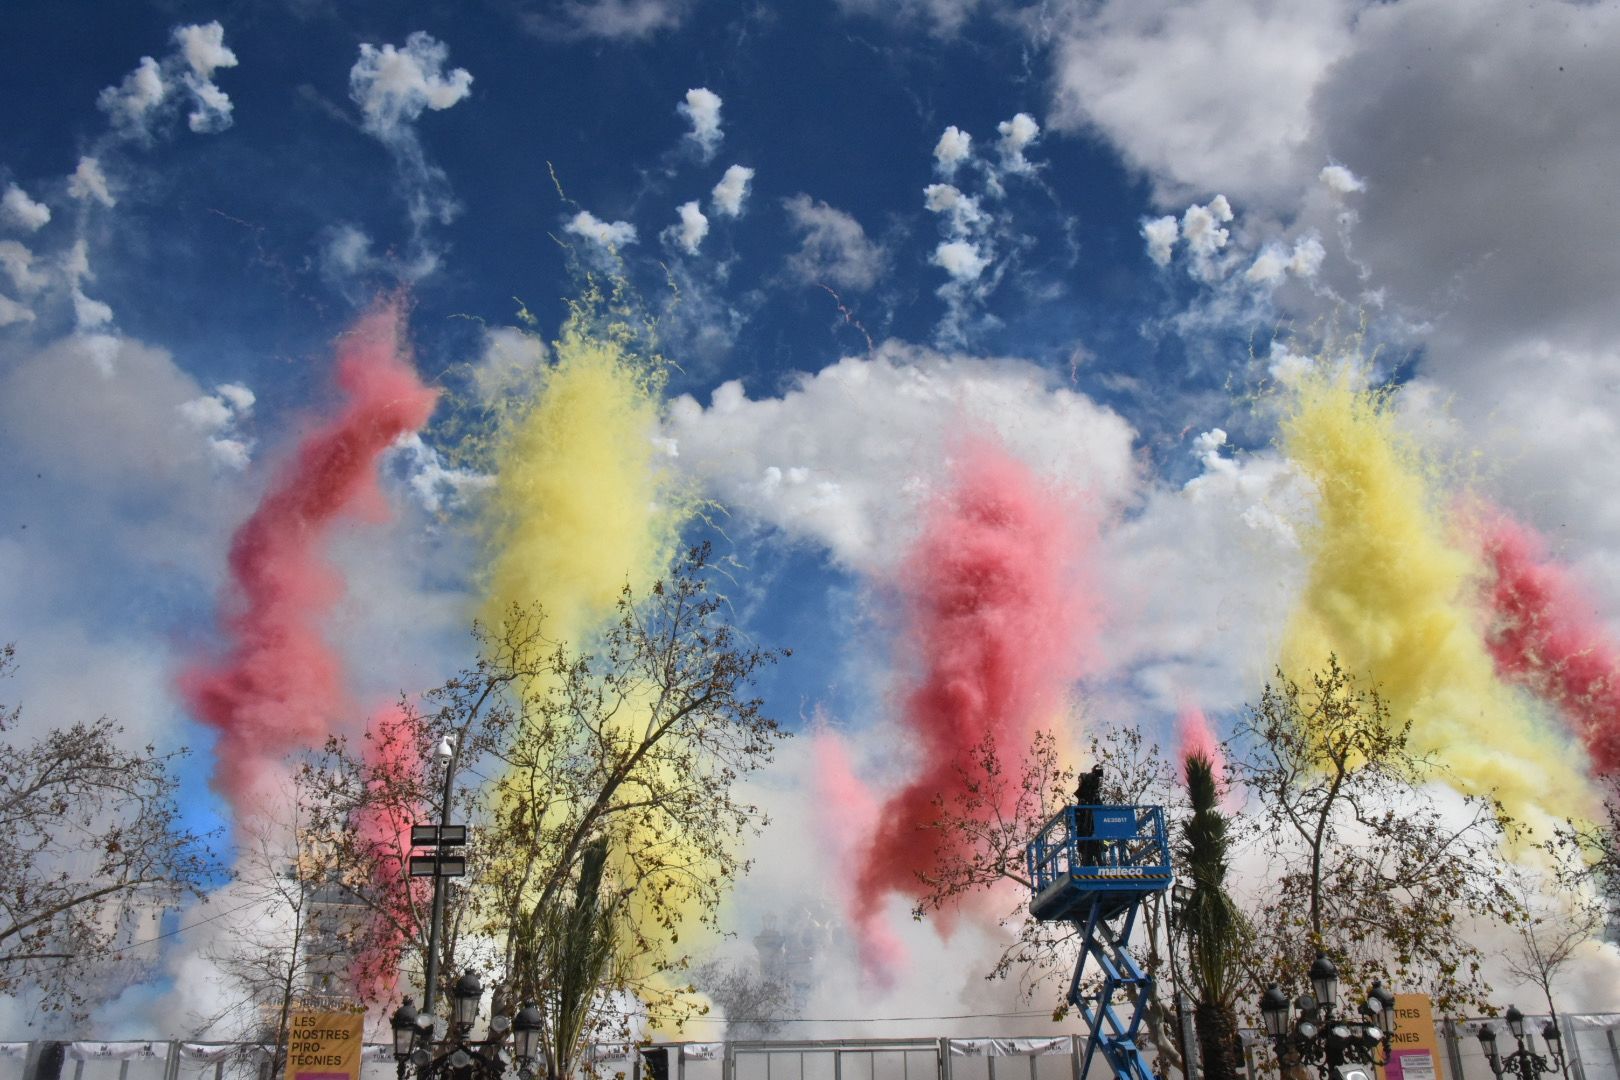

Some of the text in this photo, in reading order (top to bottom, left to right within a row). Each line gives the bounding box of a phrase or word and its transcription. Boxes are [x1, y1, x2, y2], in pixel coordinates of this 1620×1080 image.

[1097, 867, 1143, 876] mateco
[1394, 1009, 1420, 1018] TRES
[294, 1017, 316, 1026] LES
[293, 1030, 349, 1040] NOSTRES
[291, 1042, 326, 1052] PIRO-
